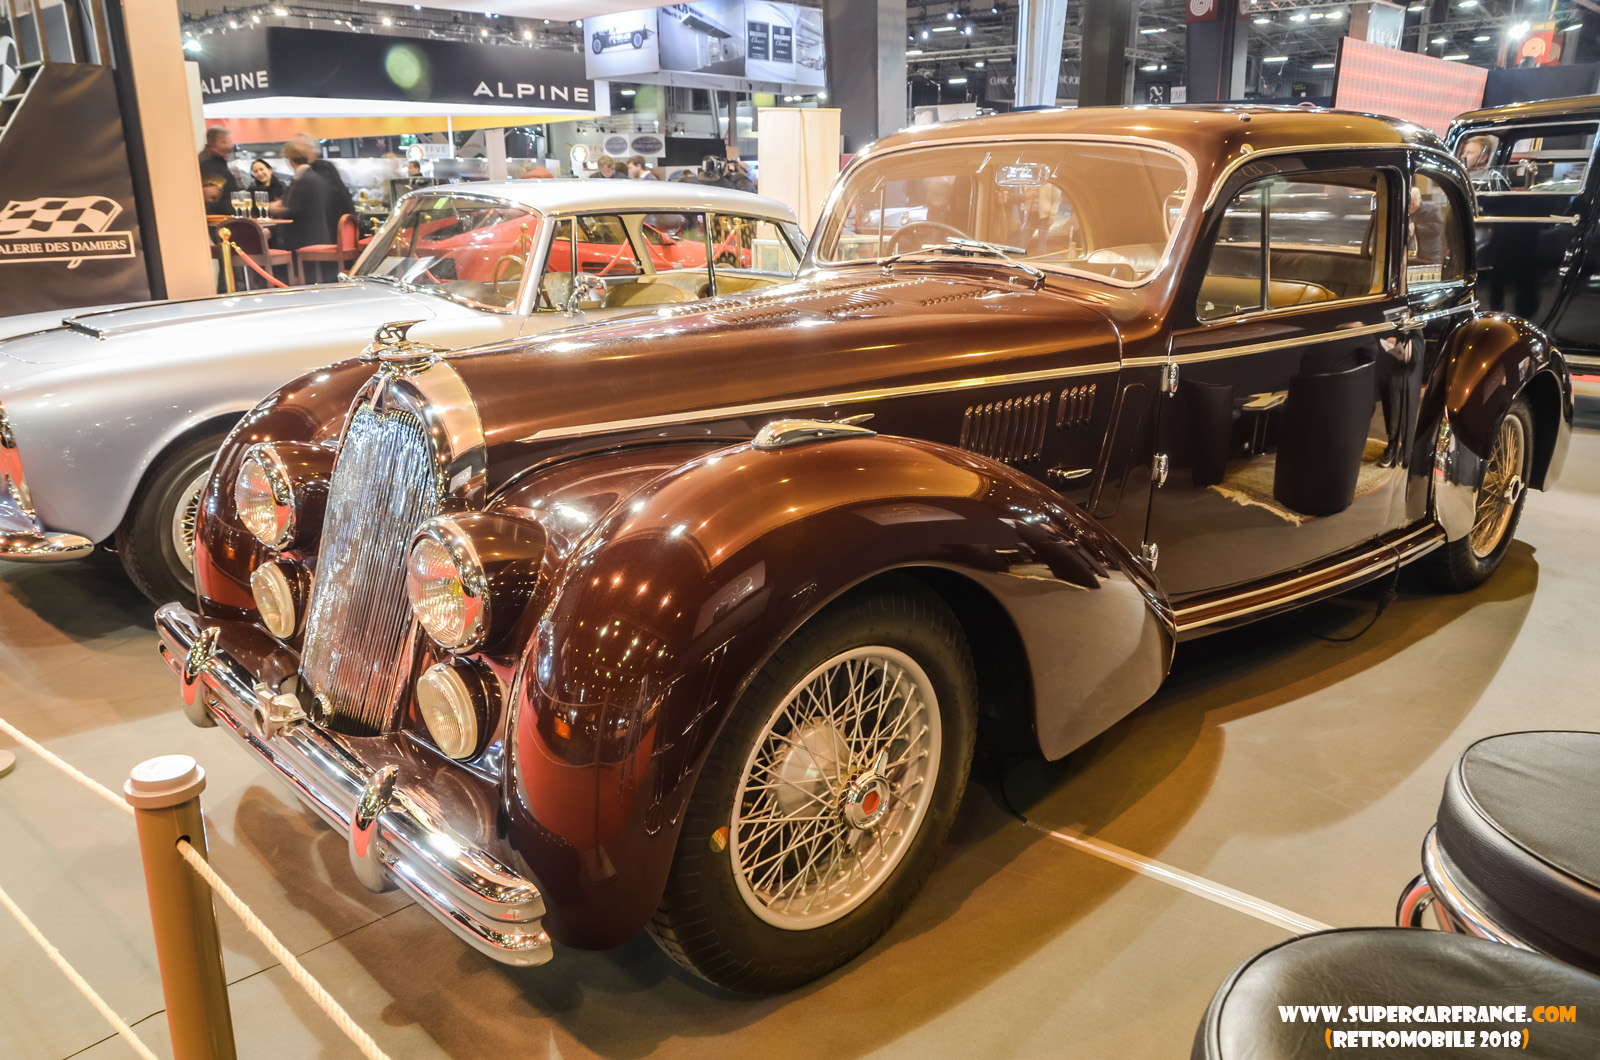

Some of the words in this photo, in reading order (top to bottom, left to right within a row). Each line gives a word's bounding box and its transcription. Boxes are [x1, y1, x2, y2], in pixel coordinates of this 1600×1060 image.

[201, 70, 269, 95] ALPINE
[473, 80, 589, 103] ALPINE
[45, 241, 71, 253] DES
[72, 239, 128, 252] DAMIERS
